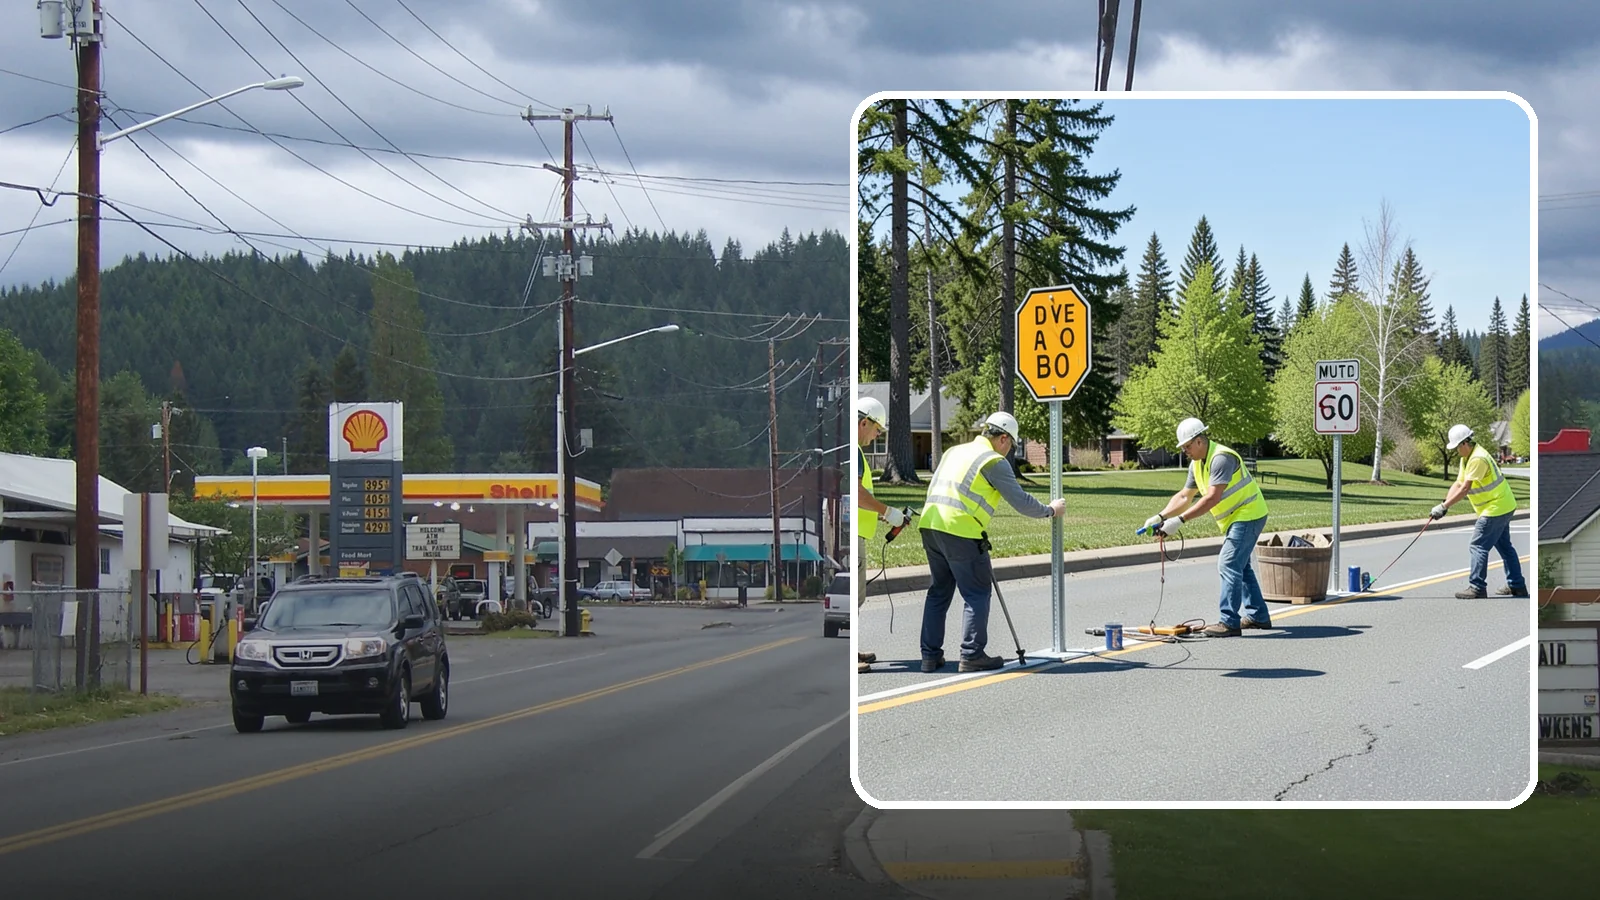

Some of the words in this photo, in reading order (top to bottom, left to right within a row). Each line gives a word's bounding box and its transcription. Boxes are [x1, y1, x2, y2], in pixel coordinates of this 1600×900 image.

[1319, 394, 1353, 420] 60
[366, 480, 384, 490] 395
[490, 484, 548, 499] Shell
[366, 494, 384, 504] 405
[366, 508, 384, 518] 415
[366, 522, 384, 533] 429
